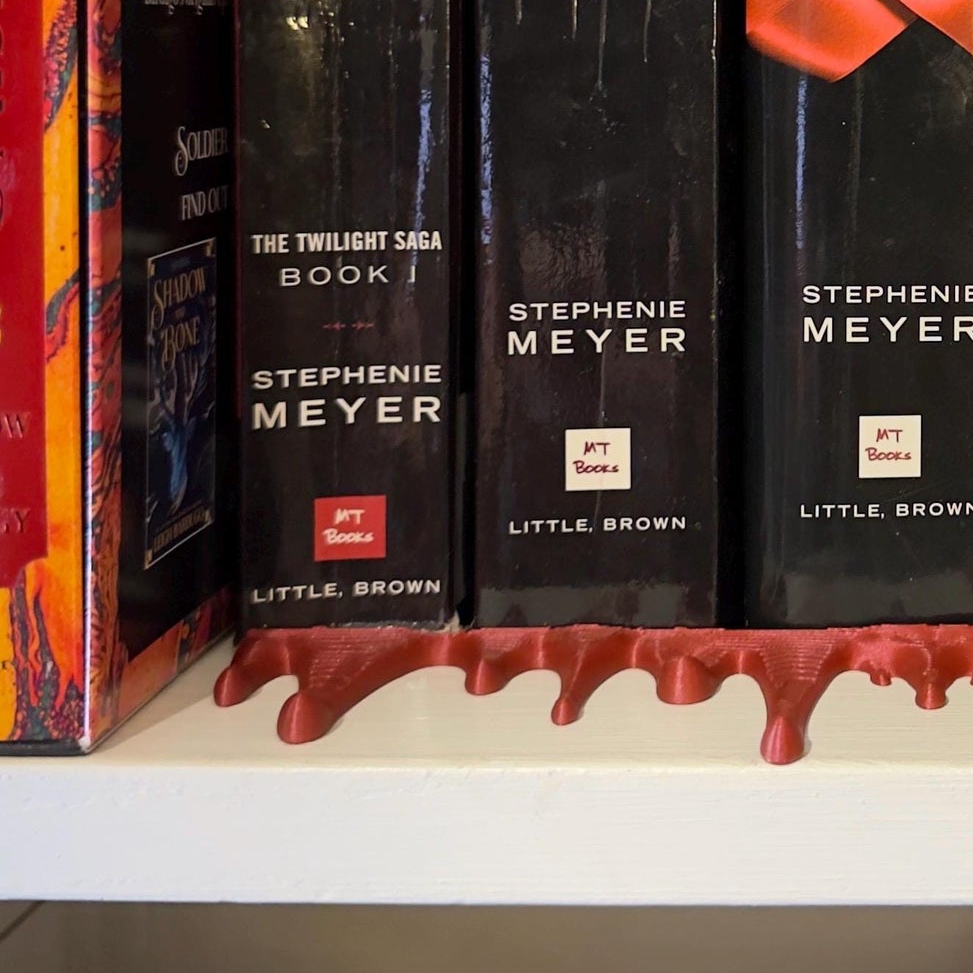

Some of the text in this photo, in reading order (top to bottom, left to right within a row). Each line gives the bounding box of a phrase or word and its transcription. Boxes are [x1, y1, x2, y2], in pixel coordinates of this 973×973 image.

[175, 125, 229, 177] SOLDIER
[182, 184, 230, 221] FIND OUT
[251, 230, 443, 254] THE TWILIGHT SAGA
[279, 265, 390, 287] BOOK
[151, 266, 206, 331] SHADOW
[508, 300, 686, 322] STEPHENIE
[160, 316, 201, 369] BONE
[507, 327, 686, 355] MEYER
[251, 365, 442, 390] STEPHENIE
[251, 396, 442, 431] MEYER
[876, 428, 904, 443] MT
[583, 441, 611, 456] MT
[333, 508, 365, 525] MT
[800, 504, 886, 520] LITTLE,
[508, 516, 686, 535] LITTLE, BROWN
[248, 579, 442, 604] LITTLE, BROWN
